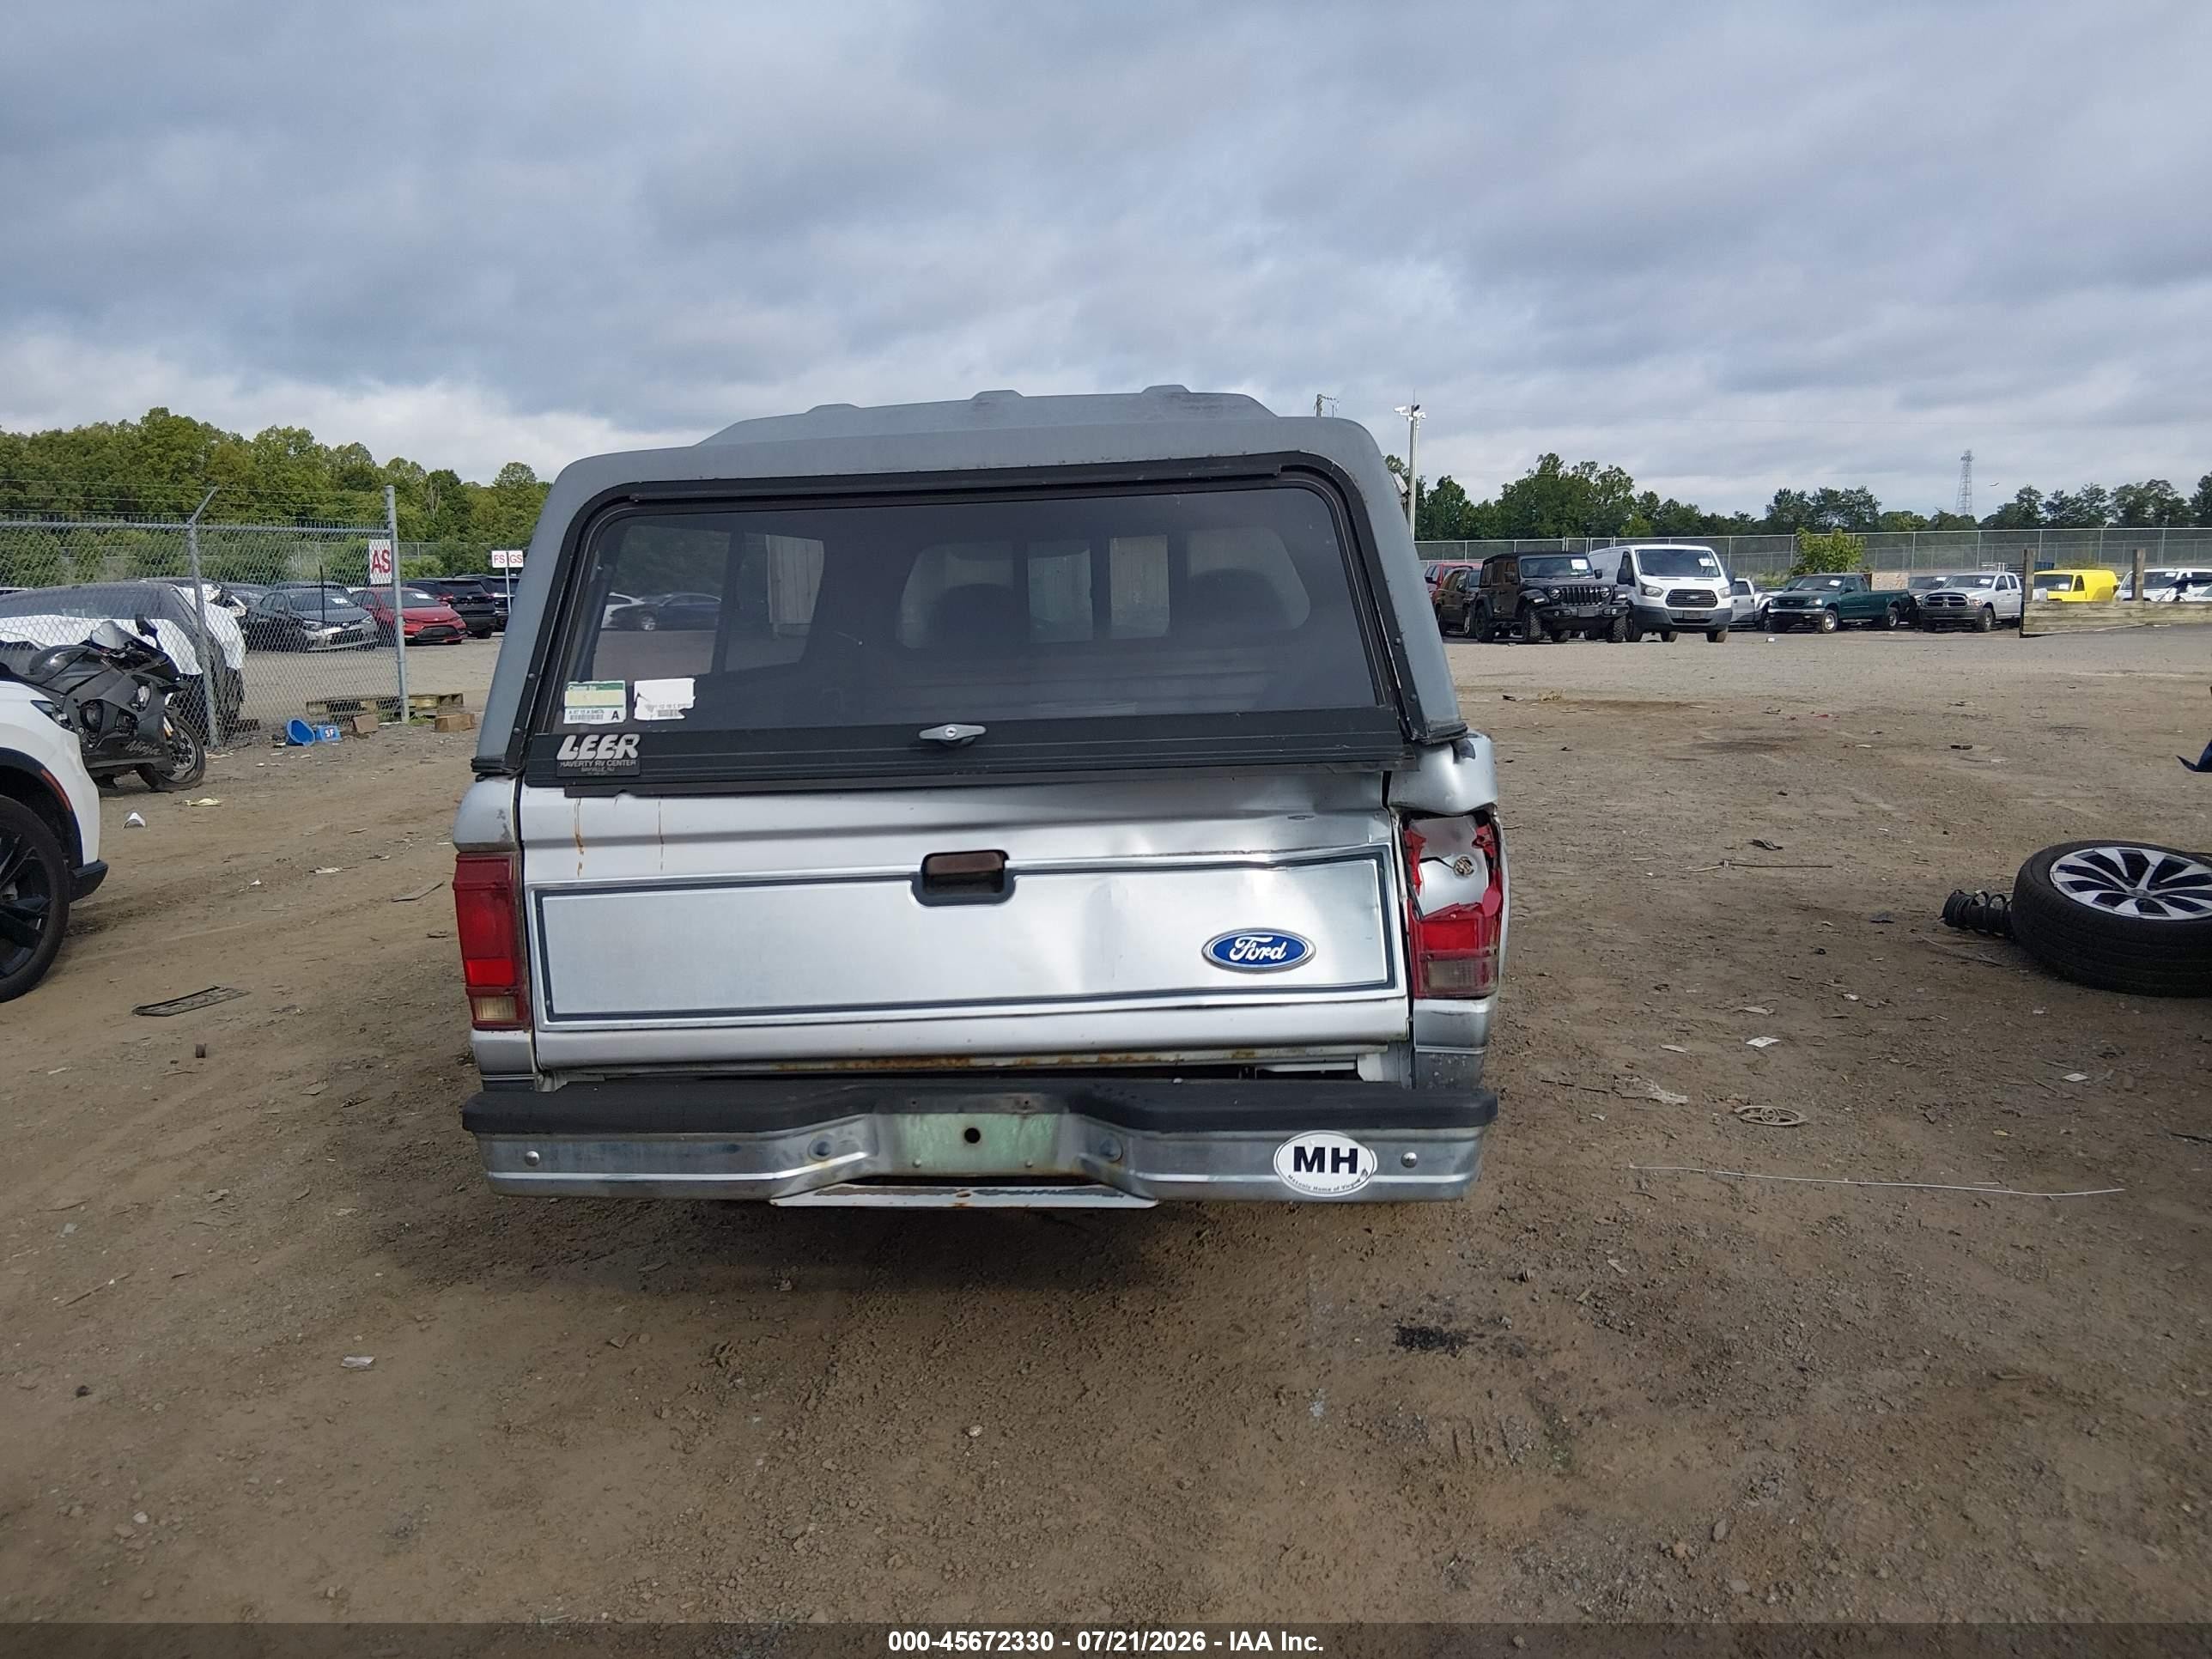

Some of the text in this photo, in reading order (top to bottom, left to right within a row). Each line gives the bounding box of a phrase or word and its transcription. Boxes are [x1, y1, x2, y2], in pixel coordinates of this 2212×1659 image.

[371, 550, 391, 574] AS
[494, 554, 505, 563] FS
[509, 554, 522, 563] GS
[611, 710, 620, 720] A
[125, 739, 162, 757] Ninja
[556, 733, 641, 761] LEER
[1229, 936, 1287, 961] Ford
[1293, 1146, 1358, 1174] MH
